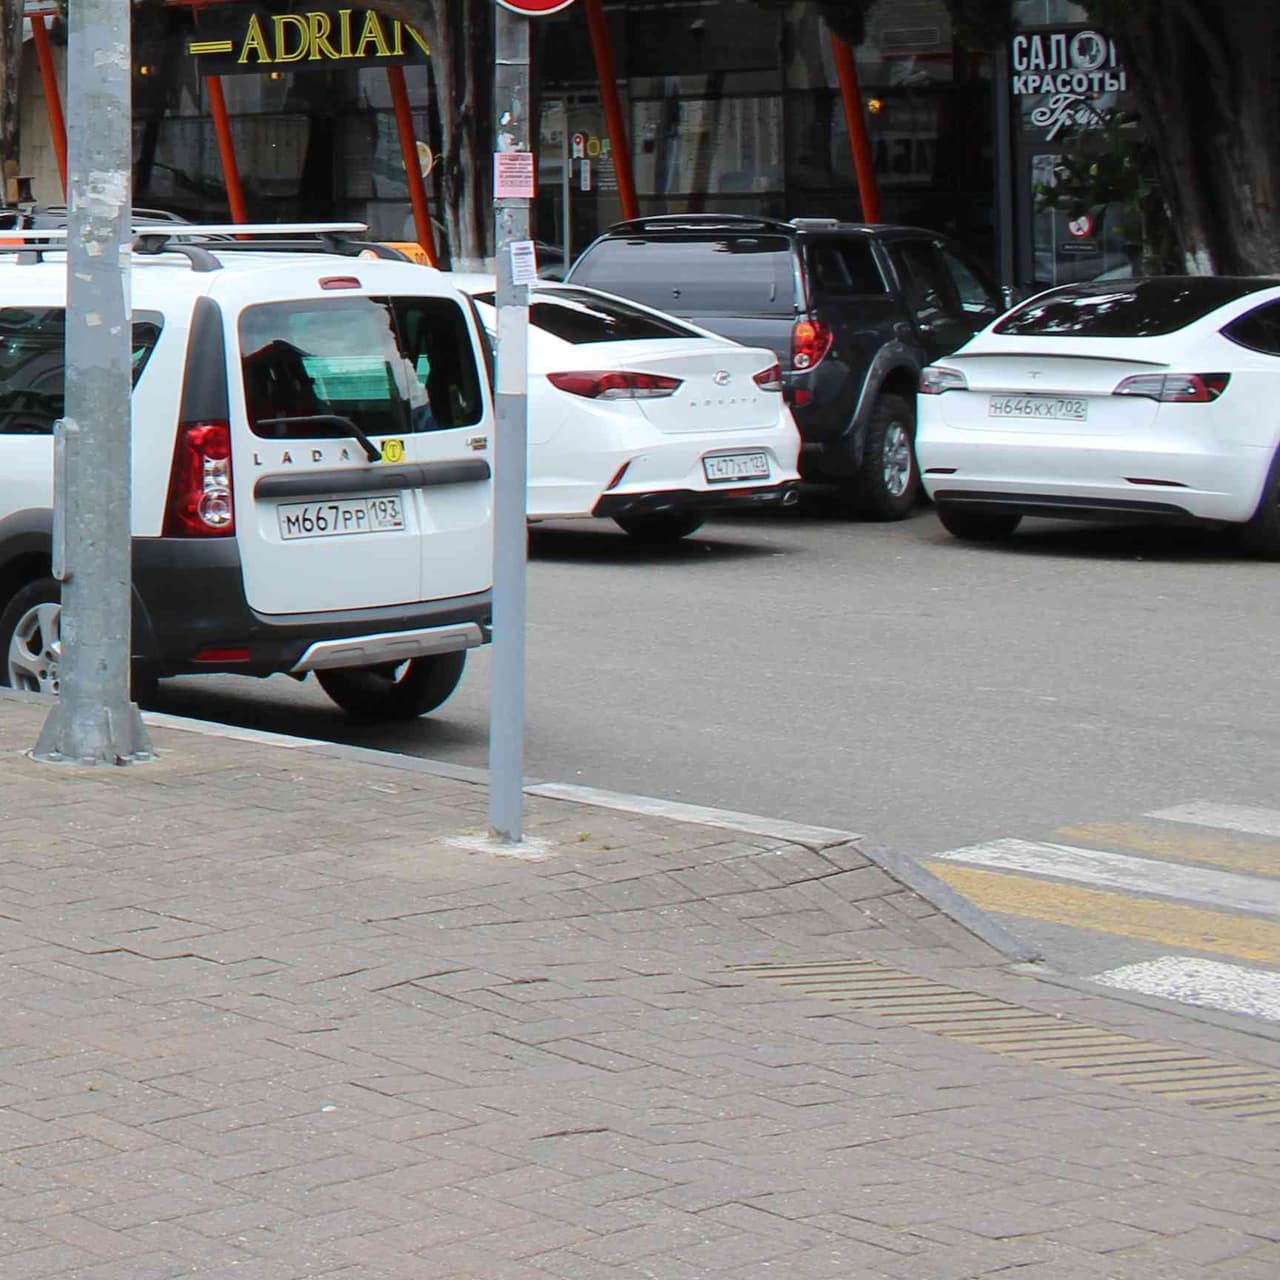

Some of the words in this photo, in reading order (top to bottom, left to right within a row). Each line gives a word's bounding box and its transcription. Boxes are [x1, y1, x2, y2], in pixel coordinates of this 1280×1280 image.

[1013, 72, 1126, 95] КРАСОТЫ
[1056, 399, 1082, 414] 702
[253, 448, 350, 466] LADA
[370, 499, 398, 520] 193
